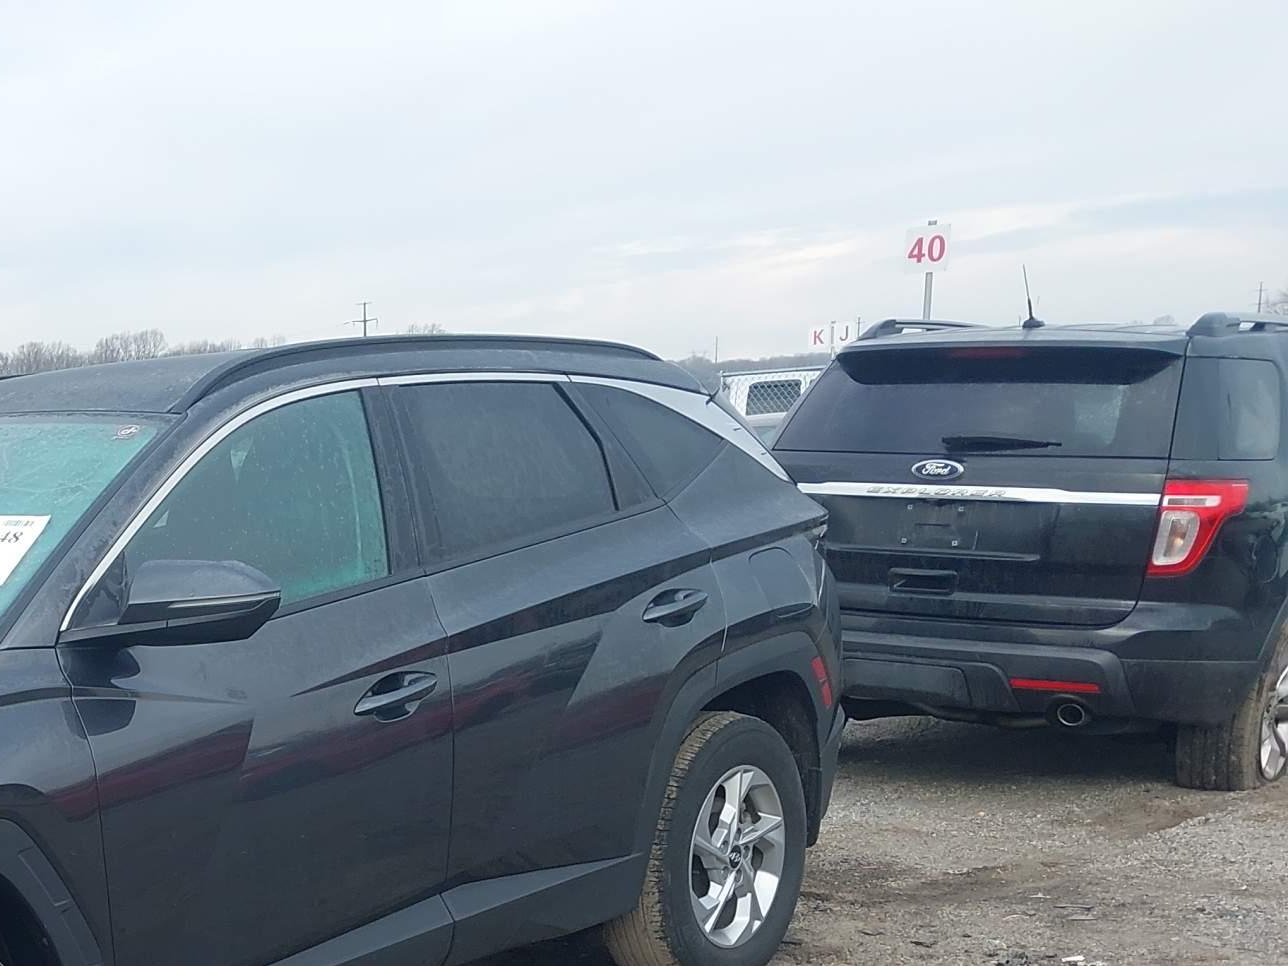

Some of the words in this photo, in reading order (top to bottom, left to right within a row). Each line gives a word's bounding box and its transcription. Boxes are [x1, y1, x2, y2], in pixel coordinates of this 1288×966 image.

[907, 235, 946, 264] 40
[812, 328, 825, 345] K
[839, 325, 849, 342] J
[921, 462, 952, 476] Ford
[866, 485, 1007, 498] EXPLORER
